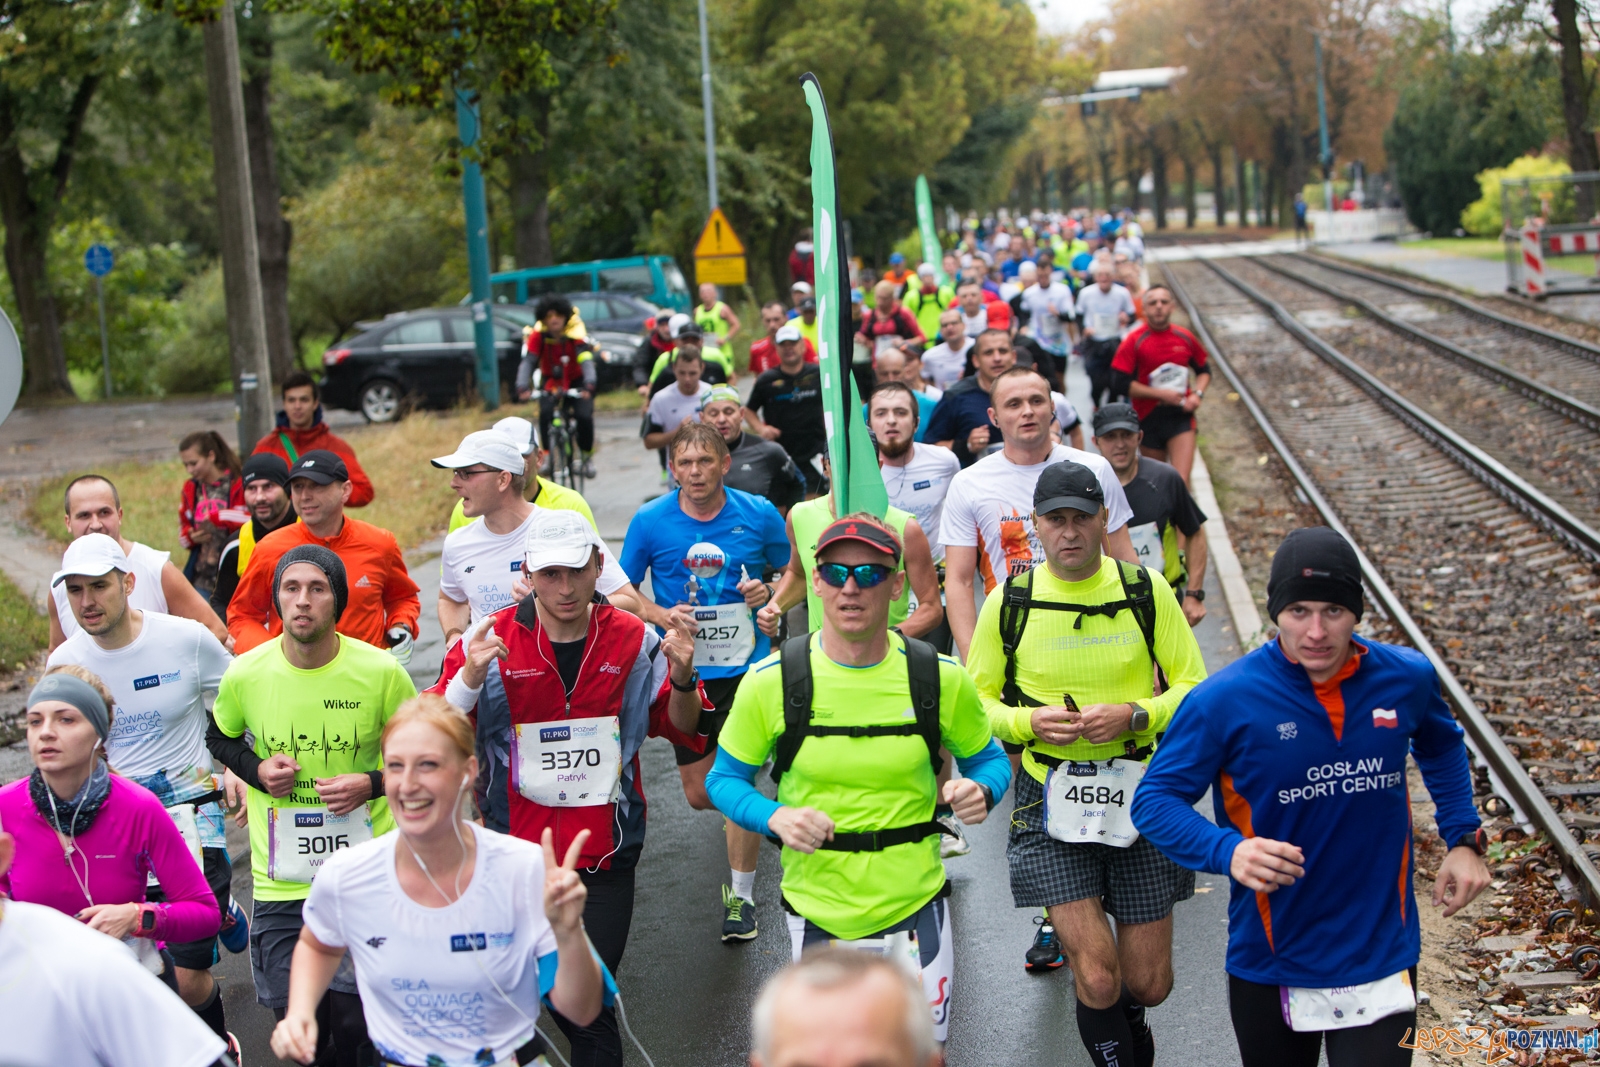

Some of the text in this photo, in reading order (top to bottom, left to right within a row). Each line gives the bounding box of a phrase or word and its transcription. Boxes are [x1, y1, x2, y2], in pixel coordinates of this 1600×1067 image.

[464, 565, 476, 574] 4F
[682, 558, 723, 569] TEAM
[477, 584, 498, 594] SIŁA
[484, 593, 513, 602] ODWA
[695, 626, 740, 641] 4257
[1082, 635, 1121, 645] CRAFT
[541, 748, 601, 771] 3370
[1306, 757, 1384, 782] GOSŁAW
[557, 773, 587, 782] Patryk
[1278, 771, 1401, 804] SPORT CENTER
[1064, 785, 1125, 808] 4684
[1081, 809, 1107, 818] Jacek
[298, 834, 349, 855] 3016
[366, 936, 387, 949] 4F
[391, 977, 430, 991] SIŁA
[404, 991, 484, 1008] ODWAGA
